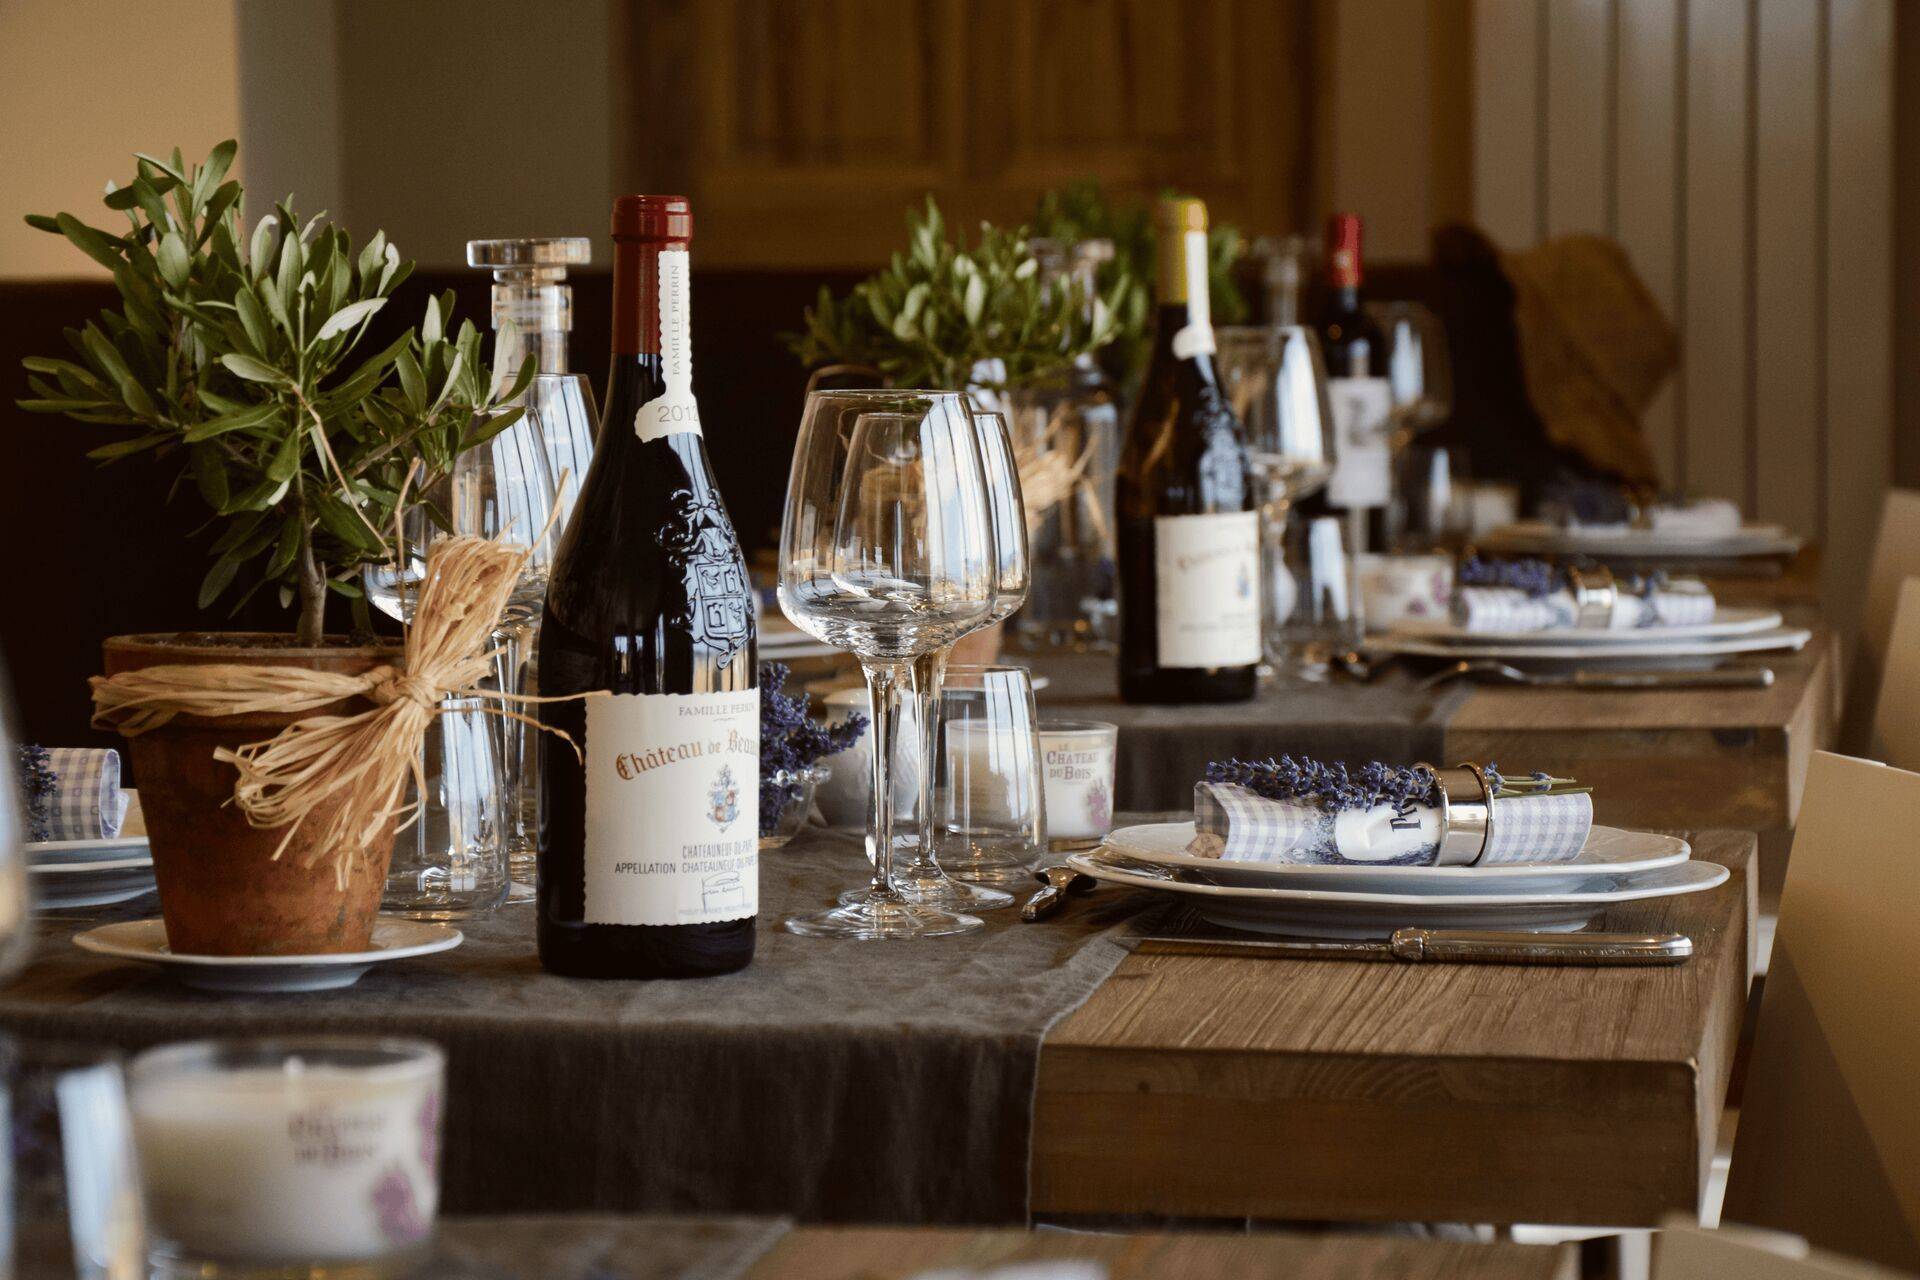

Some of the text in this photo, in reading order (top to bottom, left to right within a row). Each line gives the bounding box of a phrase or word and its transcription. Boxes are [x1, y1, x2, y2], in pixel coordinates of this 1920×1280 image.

[671, 265, 680, 375] FAMILLE PERRIN
[679, 704, 728, 716] FAMILLE
[615, 740, 704, 781] Château
[708, 742, 721, 755] de
[614, 862, 676, 874] APPELLATION
